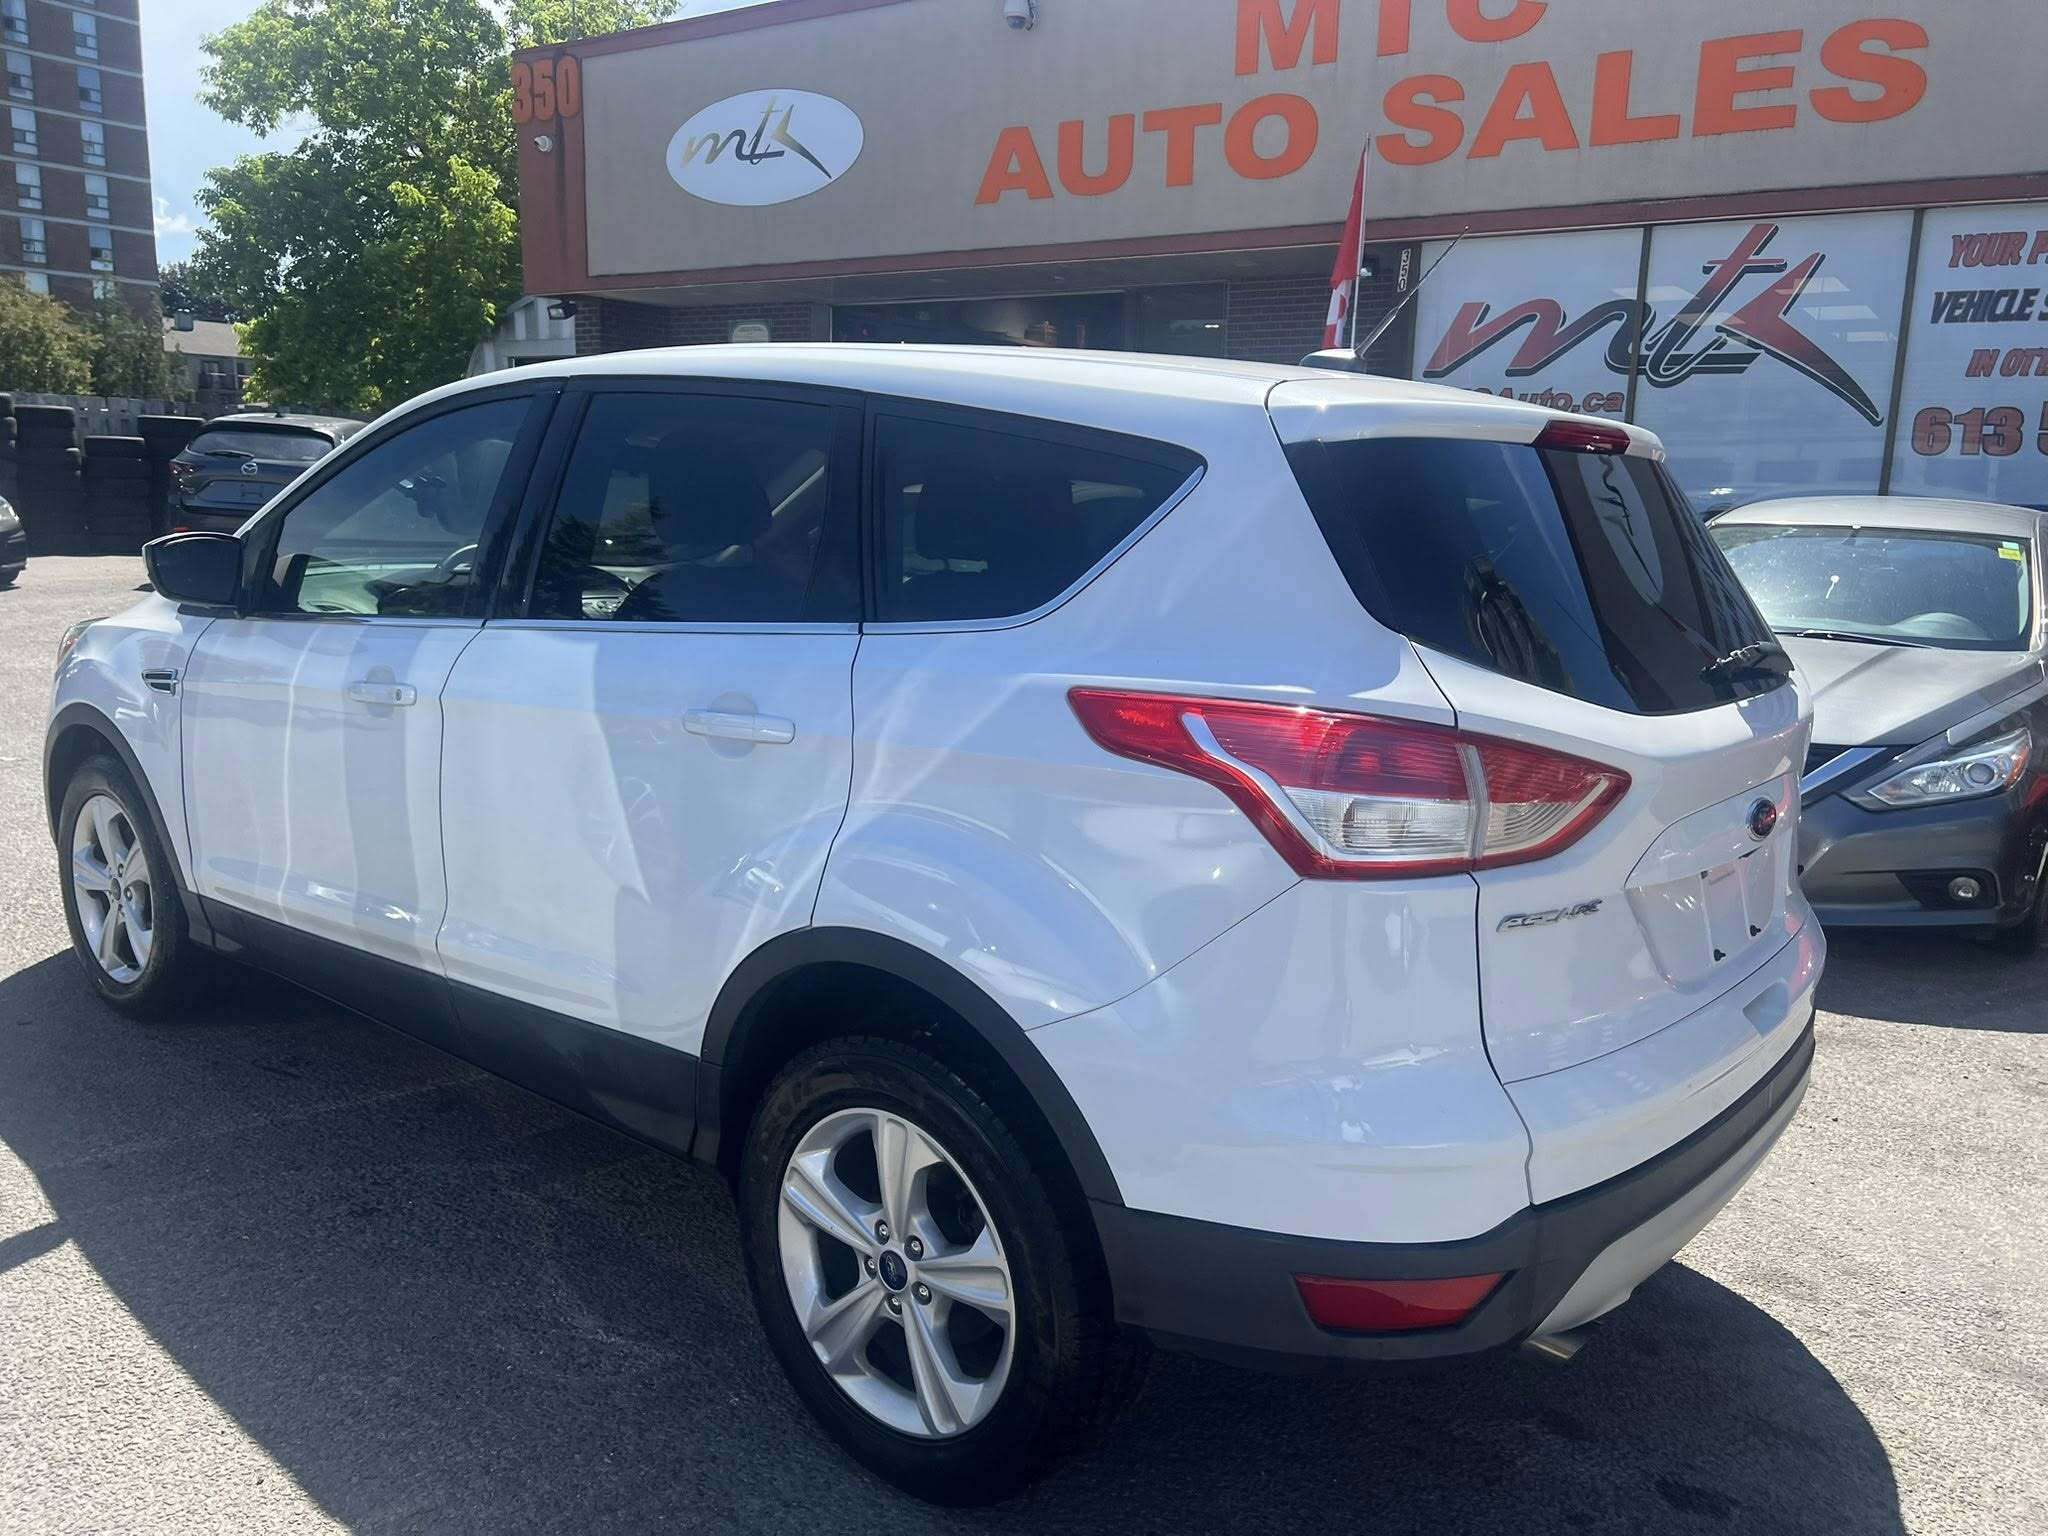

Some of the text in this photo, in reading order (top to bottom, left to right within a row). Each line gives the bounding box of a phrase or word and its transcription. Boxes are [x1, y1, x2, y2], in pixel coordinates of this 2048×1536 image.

[512, 55, 580, 123] 350
[975, 18, 1930, 205] AUTO SALES
[1399, 249, 1410, 291] 350
[1949, 230, 2048, 268] YOUR P
[1930, 288, 2040, 324] VEHICLE
[1965, 349, 2000, 378] IN
[1911, 406, 2025, 457] 613
